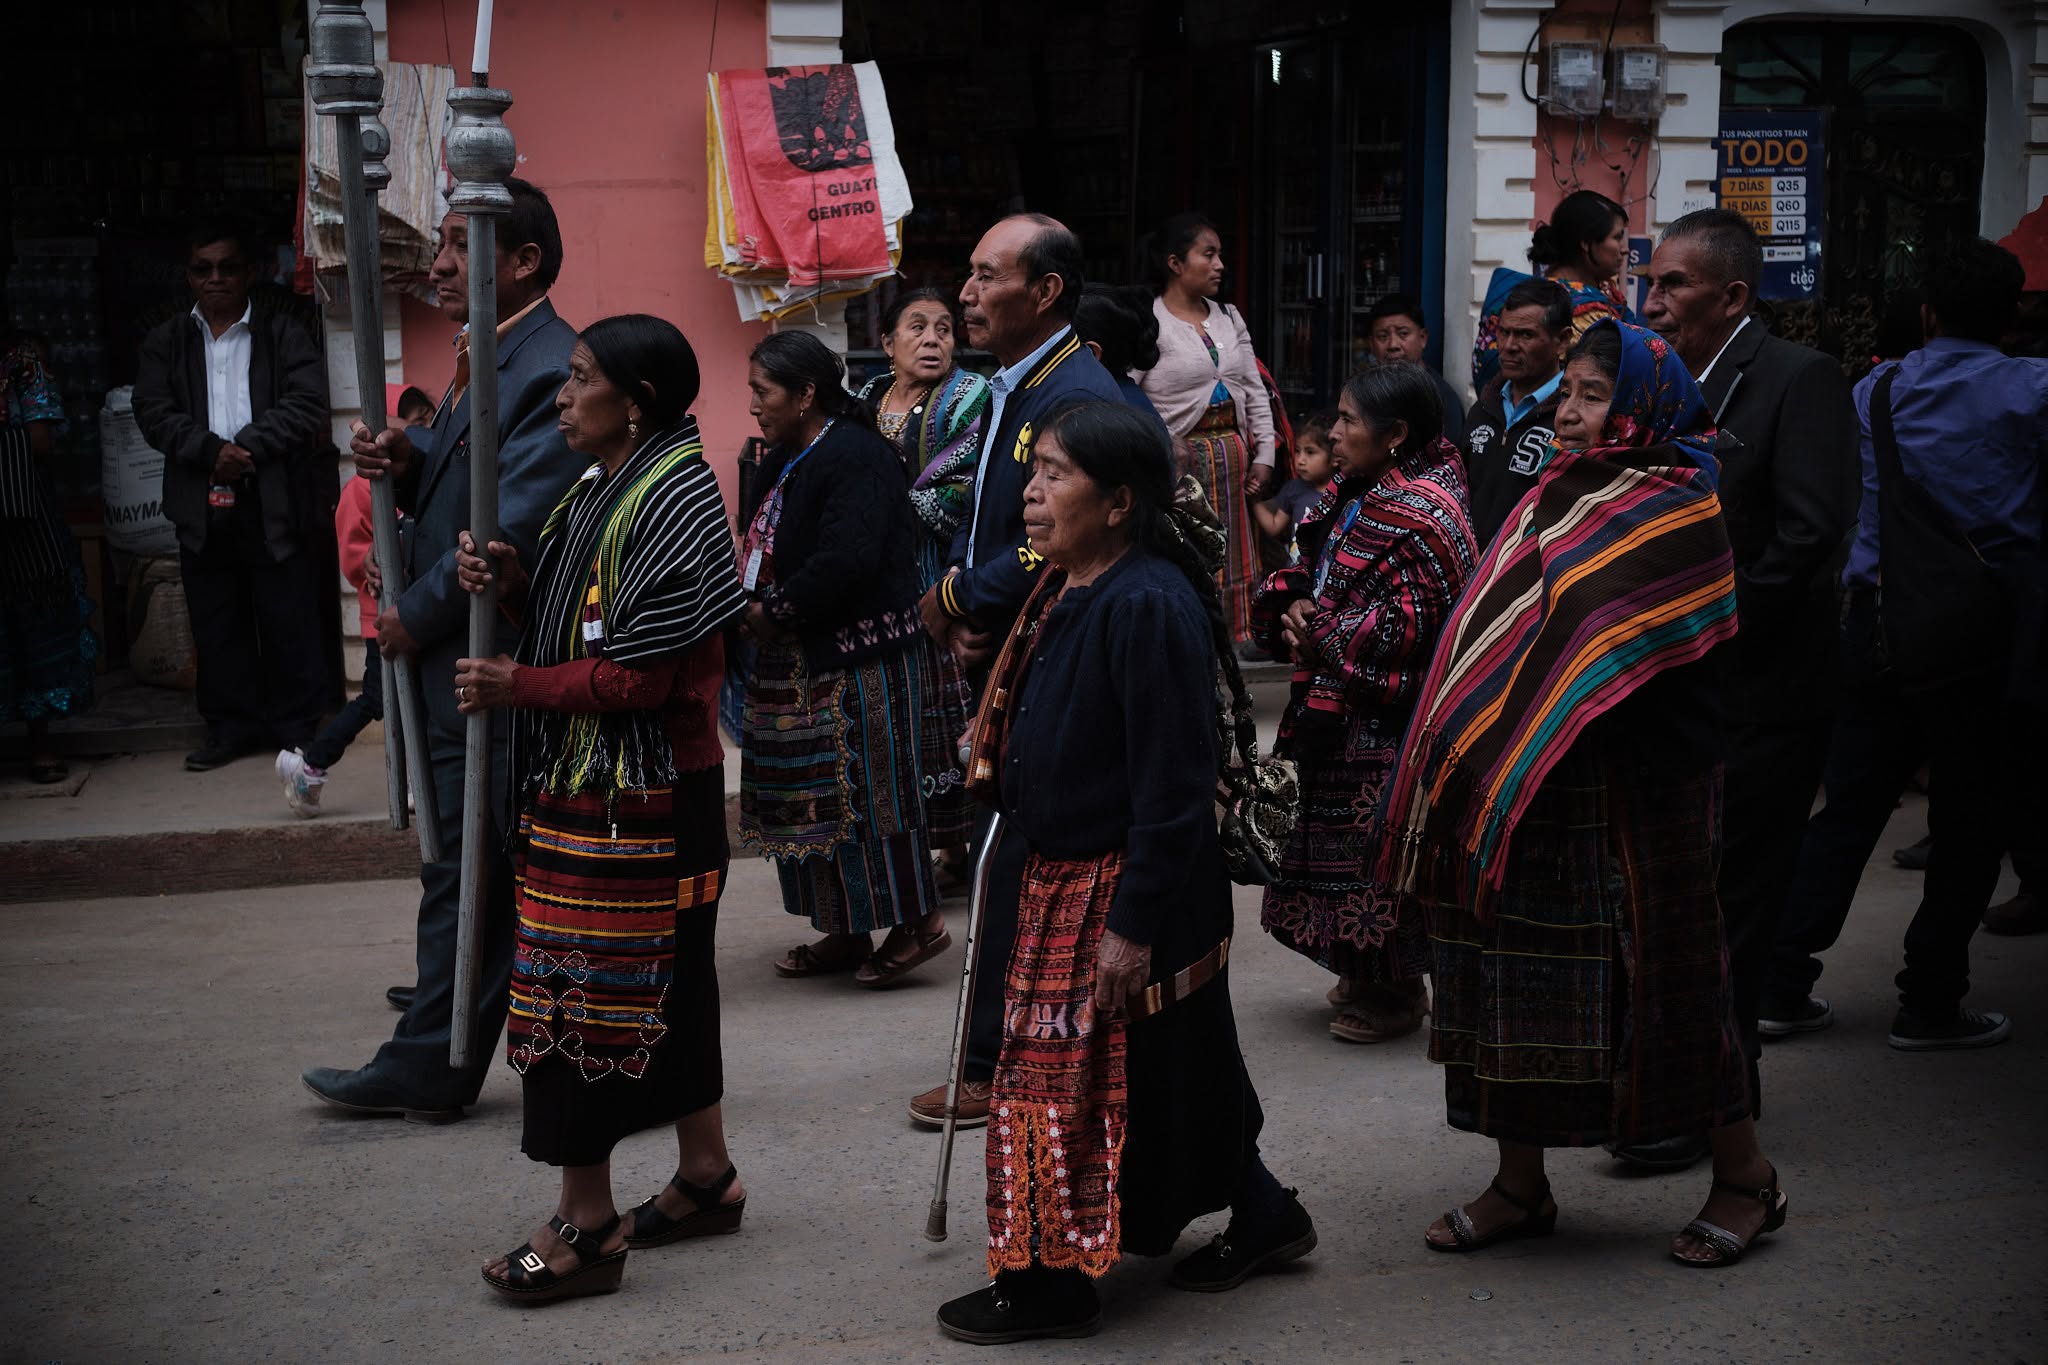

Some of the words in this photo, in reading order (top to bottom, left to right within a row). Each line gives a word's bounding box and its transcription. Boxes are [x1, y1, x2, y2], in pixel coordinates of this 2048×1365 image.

[1721, 130, 1735, 138] TUS
[1721, 139, 1808, 167] TODO
[1729, 182, 1735, 192] 7
[1738, 179, 1764, 192] DÍAS
[1776, 181, 1799, 192] Q35
[808, 200, 875, 221] CENTRO
[1741, 199, 1767, 211] DÍAS
[1776, 201, 1800, 212] Q60
[1776, 220, 1800, 232] Q115
